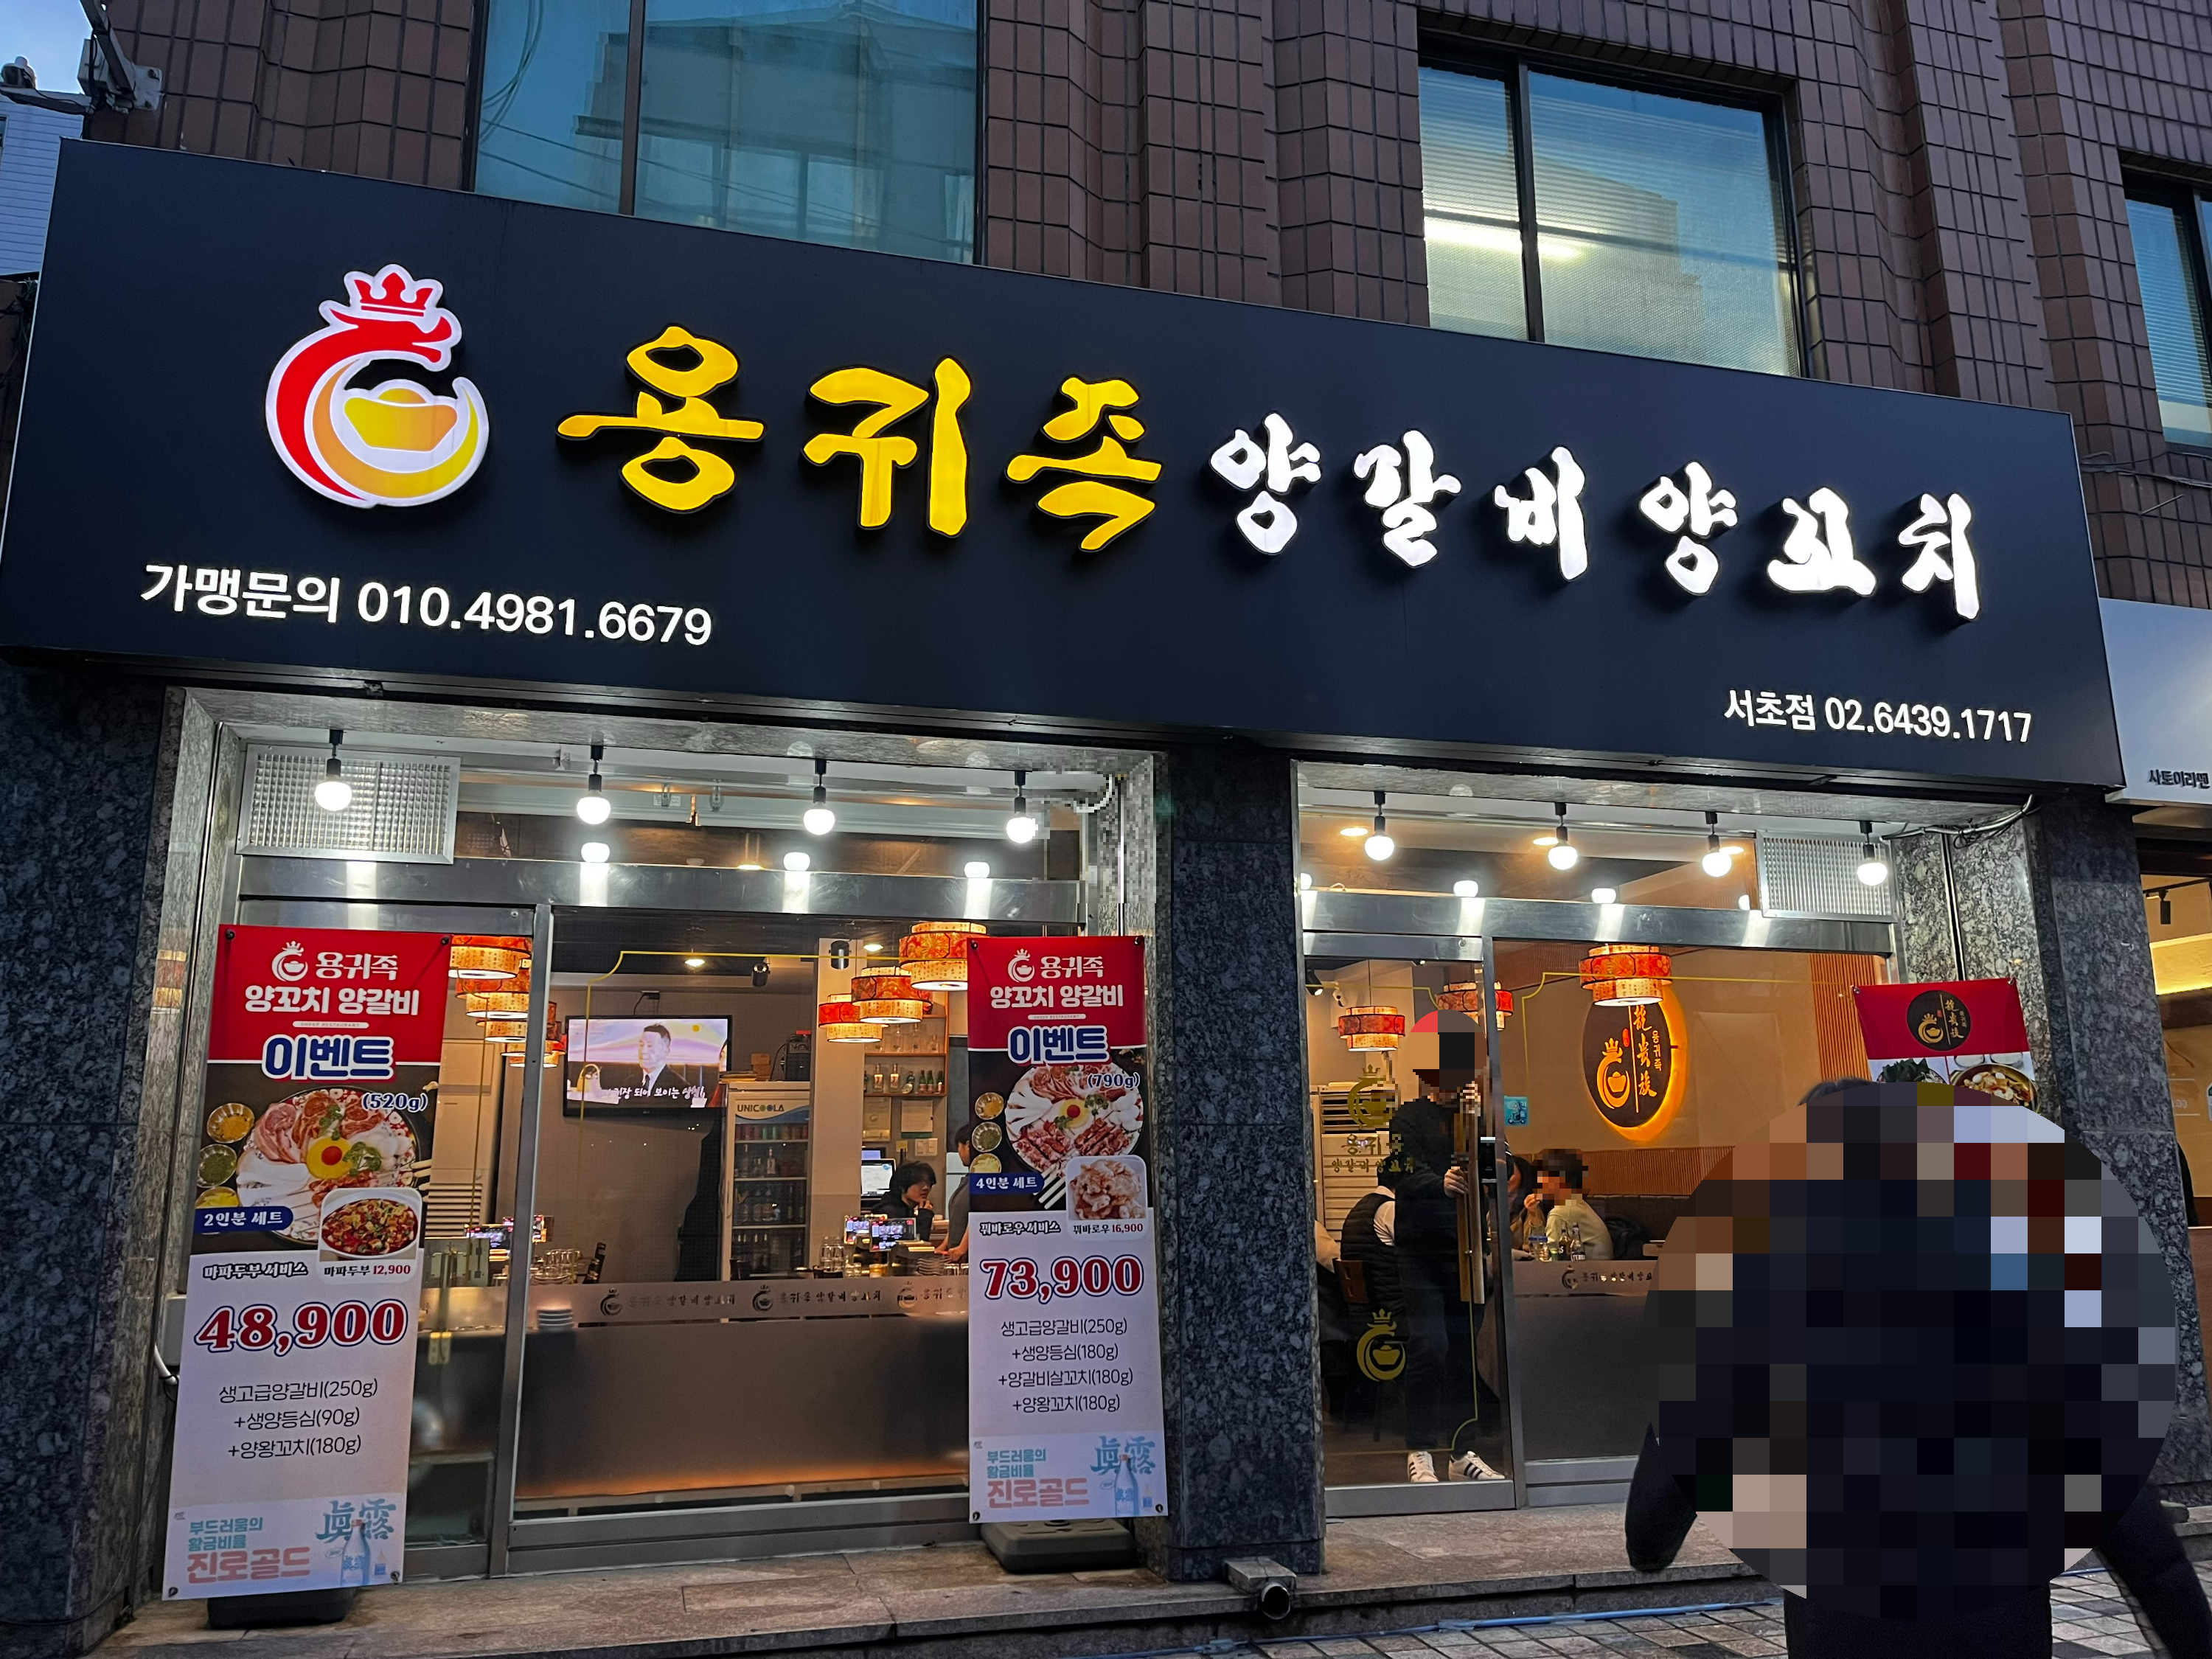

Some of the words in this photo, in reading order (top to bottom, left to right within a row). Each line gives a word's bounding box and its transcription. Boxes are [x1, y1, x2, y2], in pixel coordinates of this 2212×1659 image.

[557, 325, 1164, 553] 용귀족
[141, 562, 341, 625] 가맹문의
[357, 581, 713, 647] 010.4981.6679
[1723, 687, 1817, 732] 서초점
[1825, 696, 2032, 743] 02.6439.1717
[315, 951, 398, 981] 용귀족
[1040, 956, 1104, 978] 용귀족
[245, 985, 330, 1014] 양꼬치
[338, 988, 419, 1016] 양갈비
[990, 986, 1054, 1008] 양꼬치
[1060, 984, 1124, 1007] 양갈비
[262, 1034, 394, 1079] 이벤트
[1008, 1025, 1110, 1064] 이벤트
[1652, 1030, 1662, 1071] 용귀족
[1088, 1072, 1141, 1089] (790g)
[361, 1093, 428, 1112] (520g)
[654, 1087, 680, 1099] 보이는
[975, 1177, 1009, 1189] 4인분
[1013, 1176, 1037, 1189] 세트
[204, 1211, 248, 1228] 2인분
[251, 1210, 283, 1225] 세트
[1072, 1224, 1110, 1234] 꿔바로우
[1111, 1222, 1144, 1233] 16,900
[324, 1265, 371, 1278] 마파두부
[372, 1264, 411, 1276] 12,900
[980, 1254, 1144, 1304] 73,900
[194, 1298, 408, 1357] 48,900
[1001, 1318, 1128, 1337] 생고급양갈비(250g)
[1012, 1343, 1119, 1361] +생양등심(180g)
[998, 1368, 1133, 1388] +양갈비살꼬치(180g)
[218, 1377, 378, 1404] 생고급양갈비(250g)
[1012, 1394, 1121, 1413] +양왕꼬치(180g)
[233, 1407, 360, 1431] +생양등심(90g)
[227, 1436, 361, 1460] +양왕꼬치(180g)
[987, 1448, 1046, 1464] 부드러움의
[987, 1478, 1090, 1509] 진로골드
[189, 1517, 263, 1535] 부드러움의
[187, 1546, 310, 1585] 진로골드
